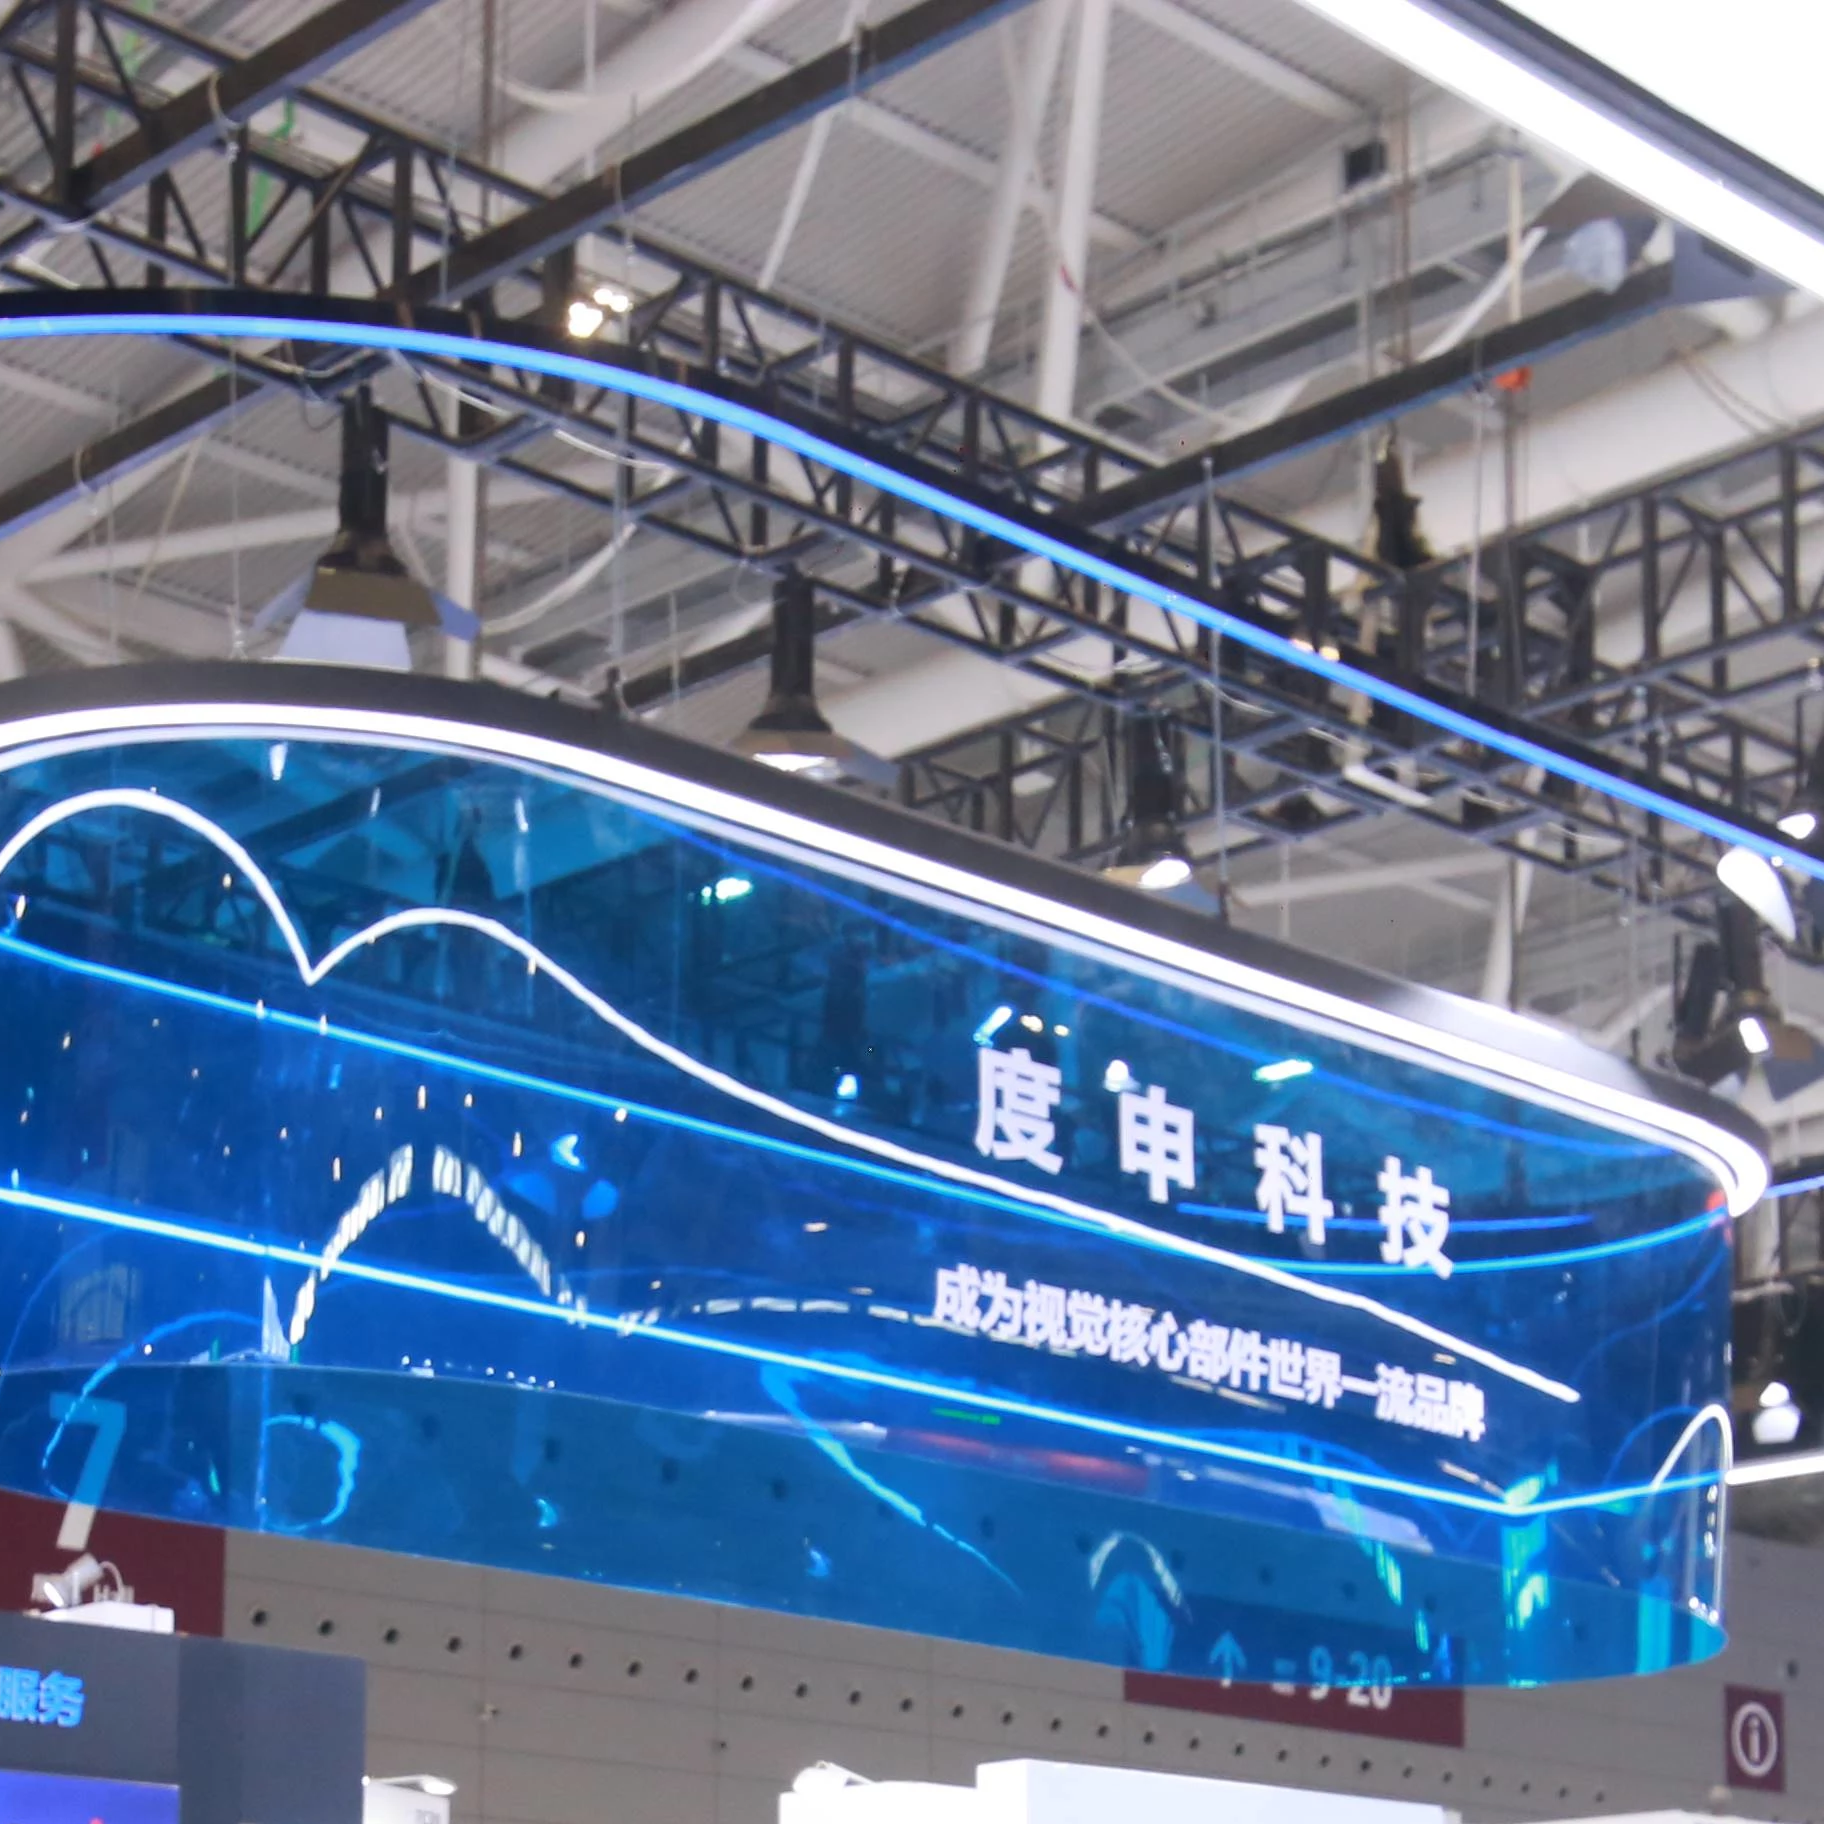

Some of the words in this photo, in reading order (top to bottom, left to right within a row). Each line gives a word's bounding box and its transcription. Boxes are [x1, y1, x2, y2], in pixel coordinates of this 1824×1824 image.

[975, 1046, 1454, 1279] 度申科技
[934, 1263, 1487, 1443] 成为视觉核心部件世界一流品牌
[49, 1391, 128, 1551] 7
